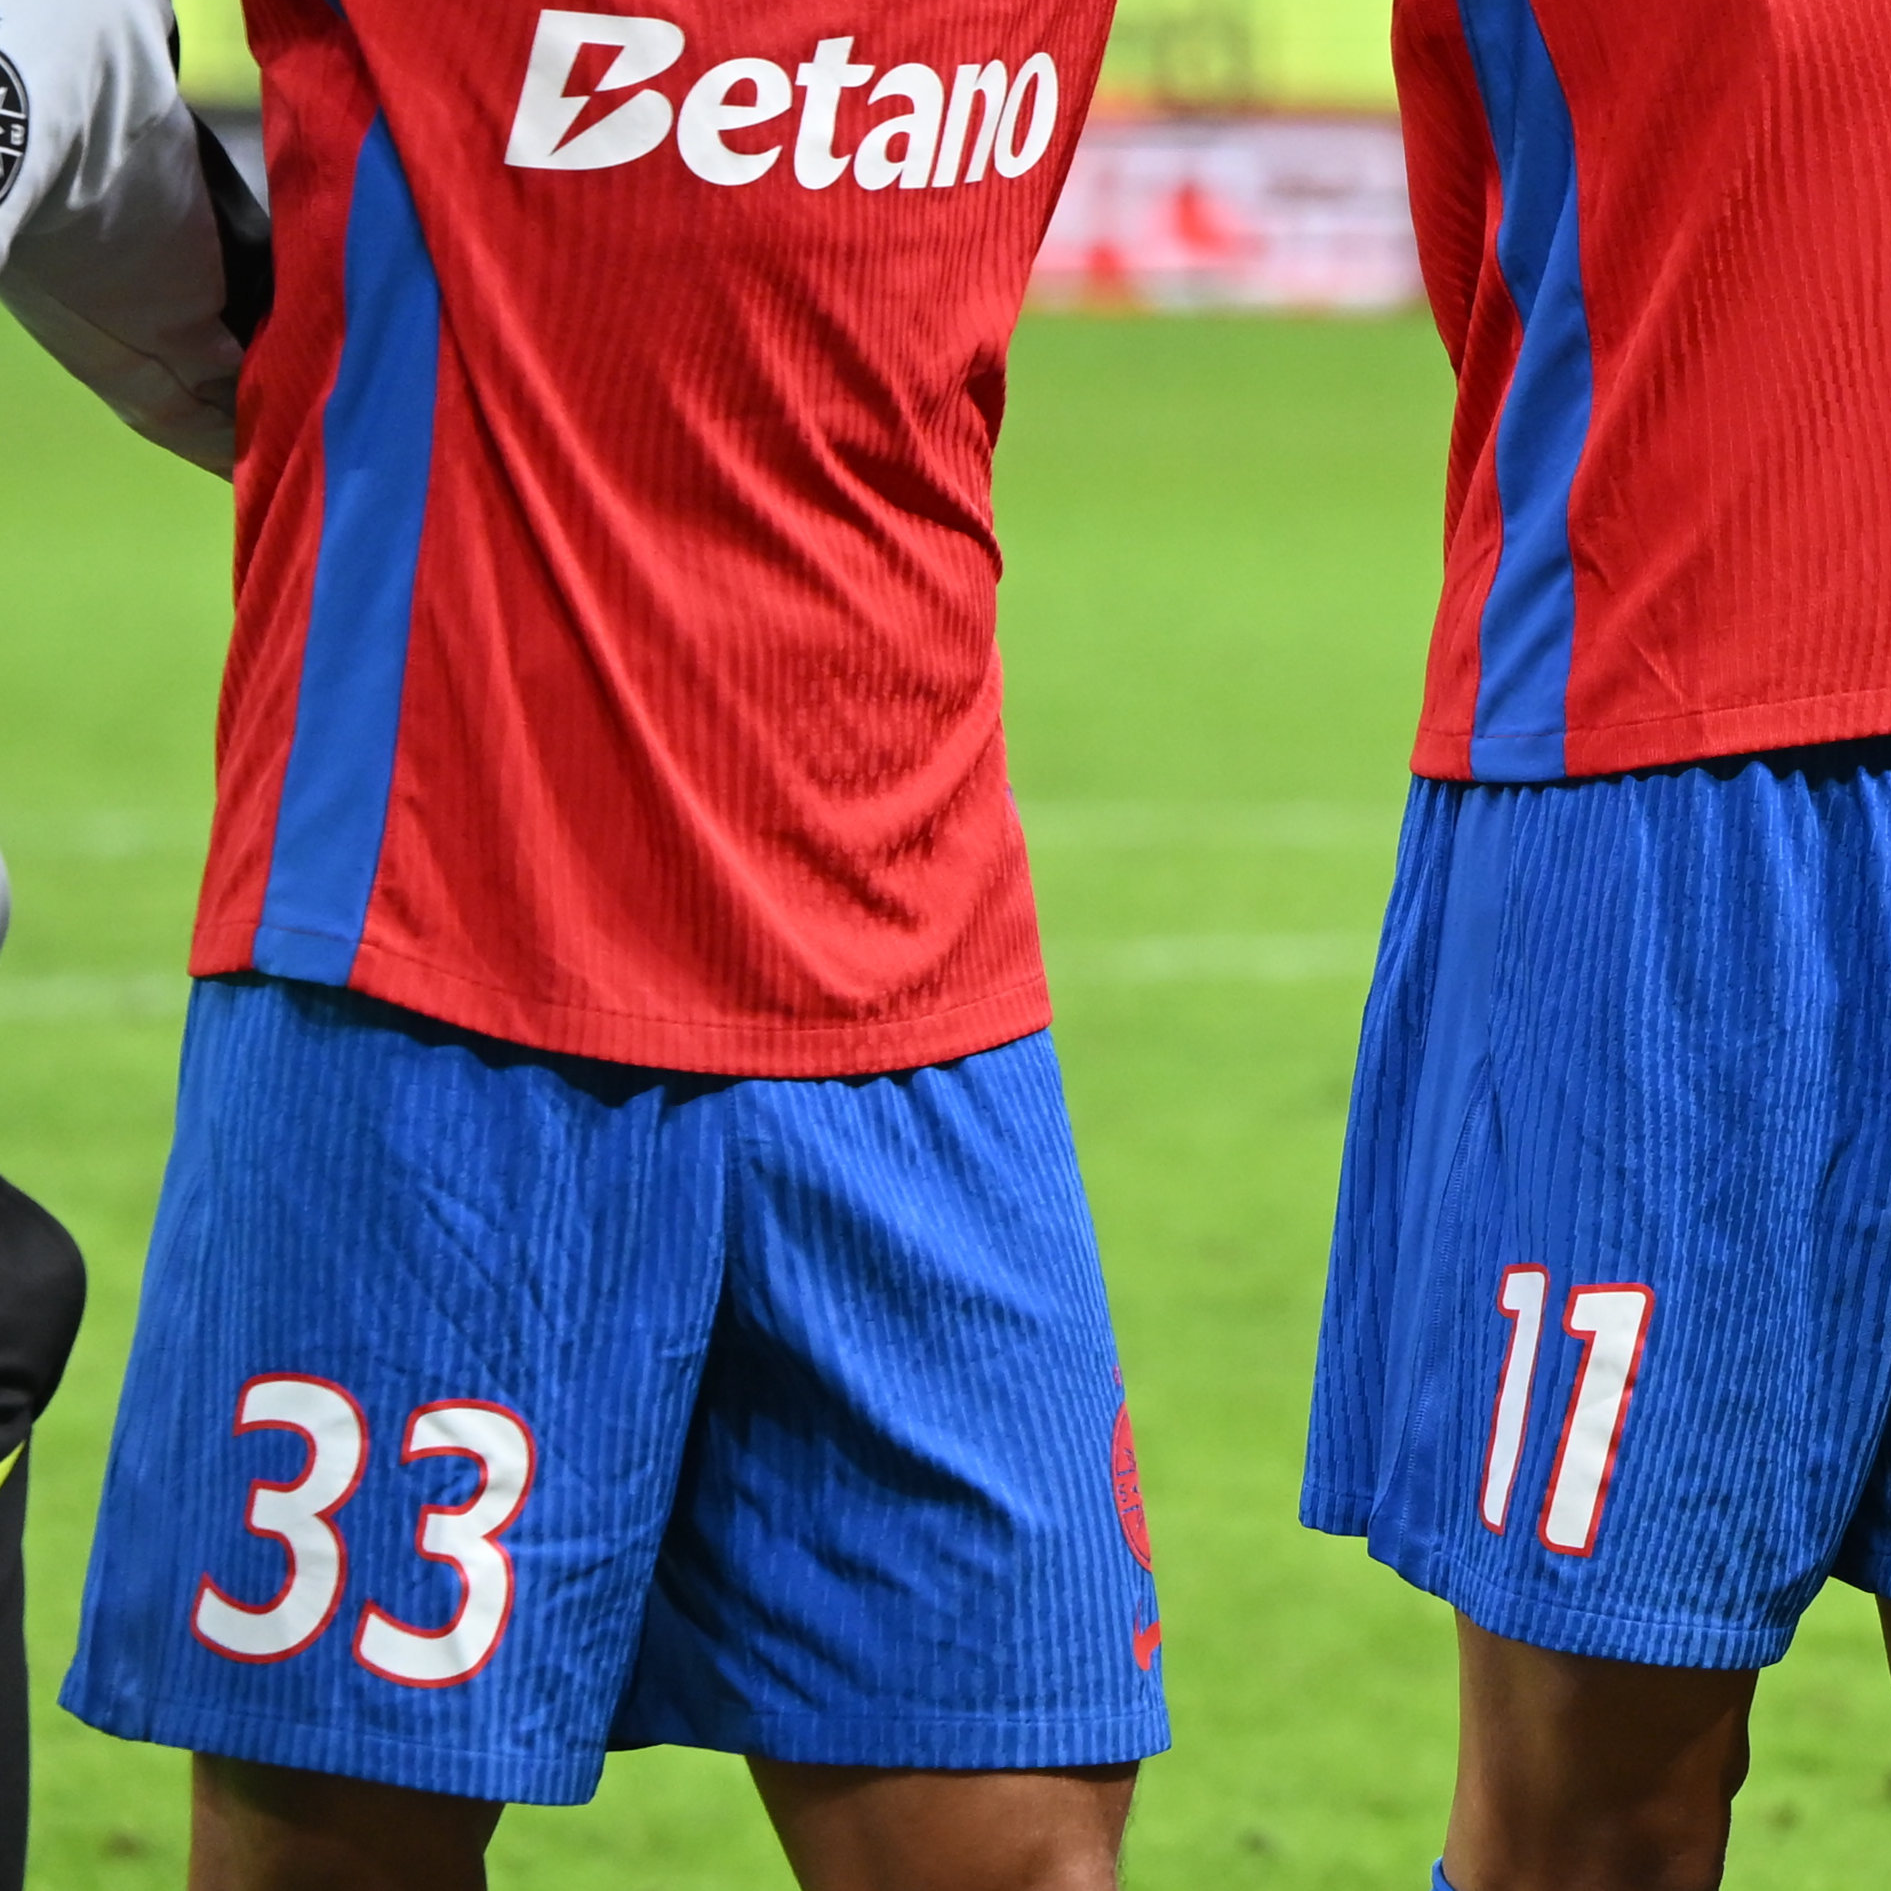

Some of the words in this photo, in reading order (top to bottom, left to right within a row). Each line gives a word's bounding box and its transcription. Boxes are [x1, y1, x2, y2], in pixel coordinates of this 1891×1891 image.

[505, 9, 1059, 191] Betano
[191, 1373, 535, 1688] 33
[1479, 1263, 1654, 1557] 11
